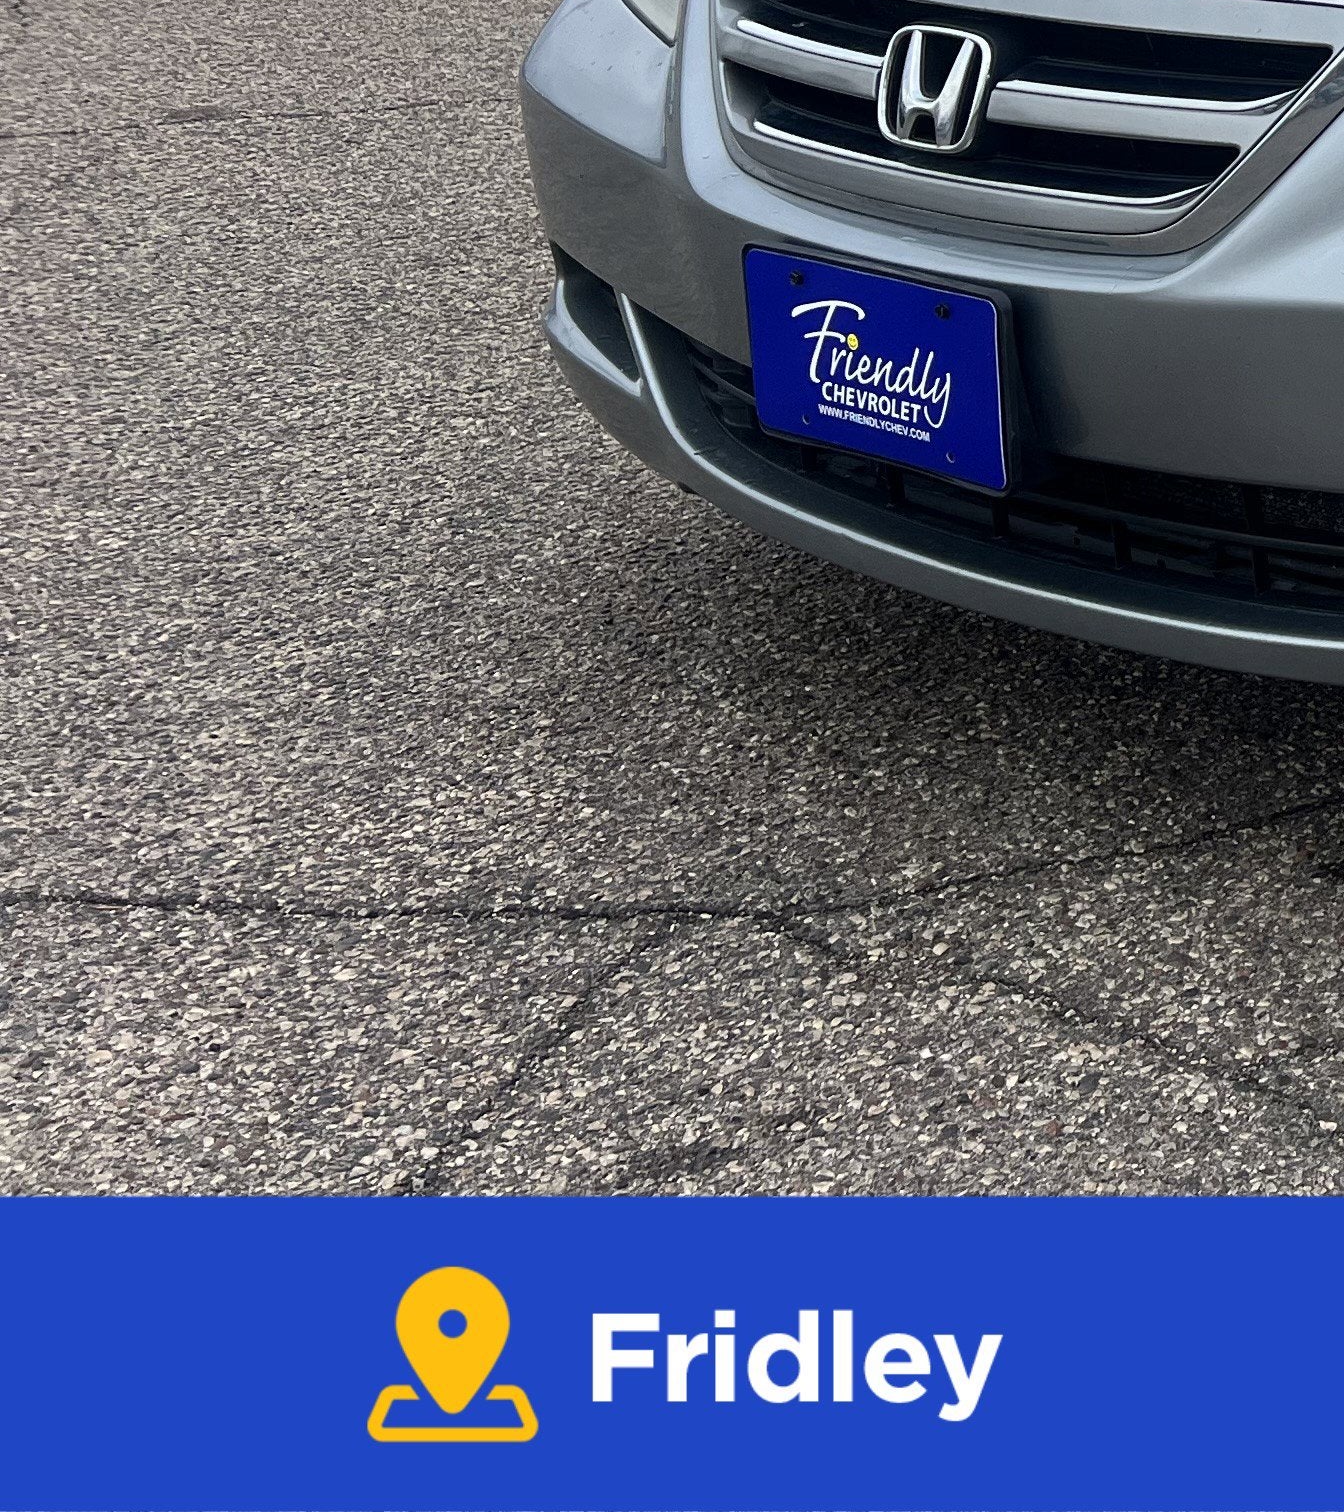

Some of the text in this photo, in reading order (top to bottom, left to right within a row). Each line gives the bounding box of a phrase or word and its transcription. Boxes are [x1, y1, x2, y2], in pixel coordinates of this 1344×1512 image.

[791, 300, 951, 429] Friendly
[818, 403, 931, 443] WWW.FRIENDLYCHEV.COM
[821, 381, 922, 423] CHEVROLET
